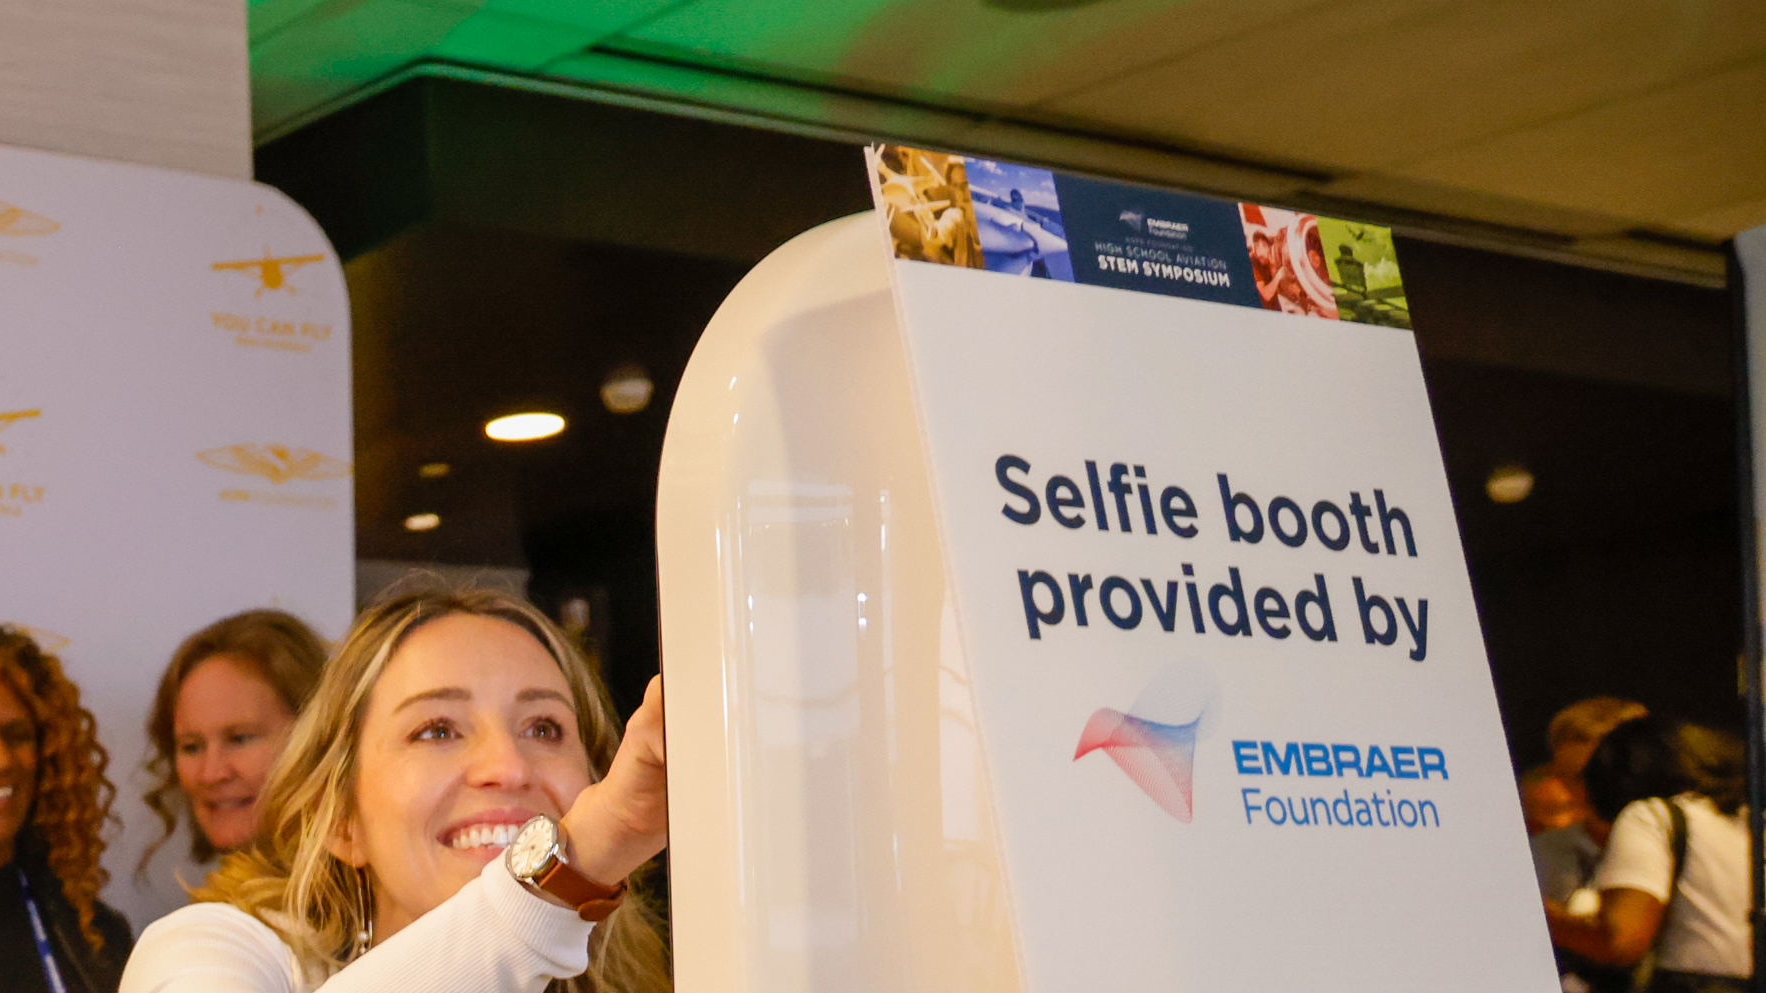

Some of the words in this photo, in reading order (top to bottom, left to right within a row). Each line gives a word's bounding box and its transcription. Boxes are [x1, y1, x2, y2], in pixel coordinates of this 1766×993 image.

[1147, 218, 1189, 232] EMBRAER
[1095, 241, 1122, 255] HIGH
[1126, 246, 1172, 262] SCHOOL
[1176, 253, 1227, 270] AVIATION
[1098, 255, 1139, 275] STEM
[1143, 261, 1230, 287] SYMPOSIUM
[211, 312, 251, 332] YOU
[255, 317, 295, 336] CAN
[10, 483, 45, 503] FLY
[995, 454, 1200, 538] Selfie
[1217, 472, 1418, 557] booth
[1017, 562, 1338, 643] provided
[1352, 577, 1429, 662] by
[1232, 740, 1450, 780] EMBRAER
[1241, 788, 1440, 828] Foundation
